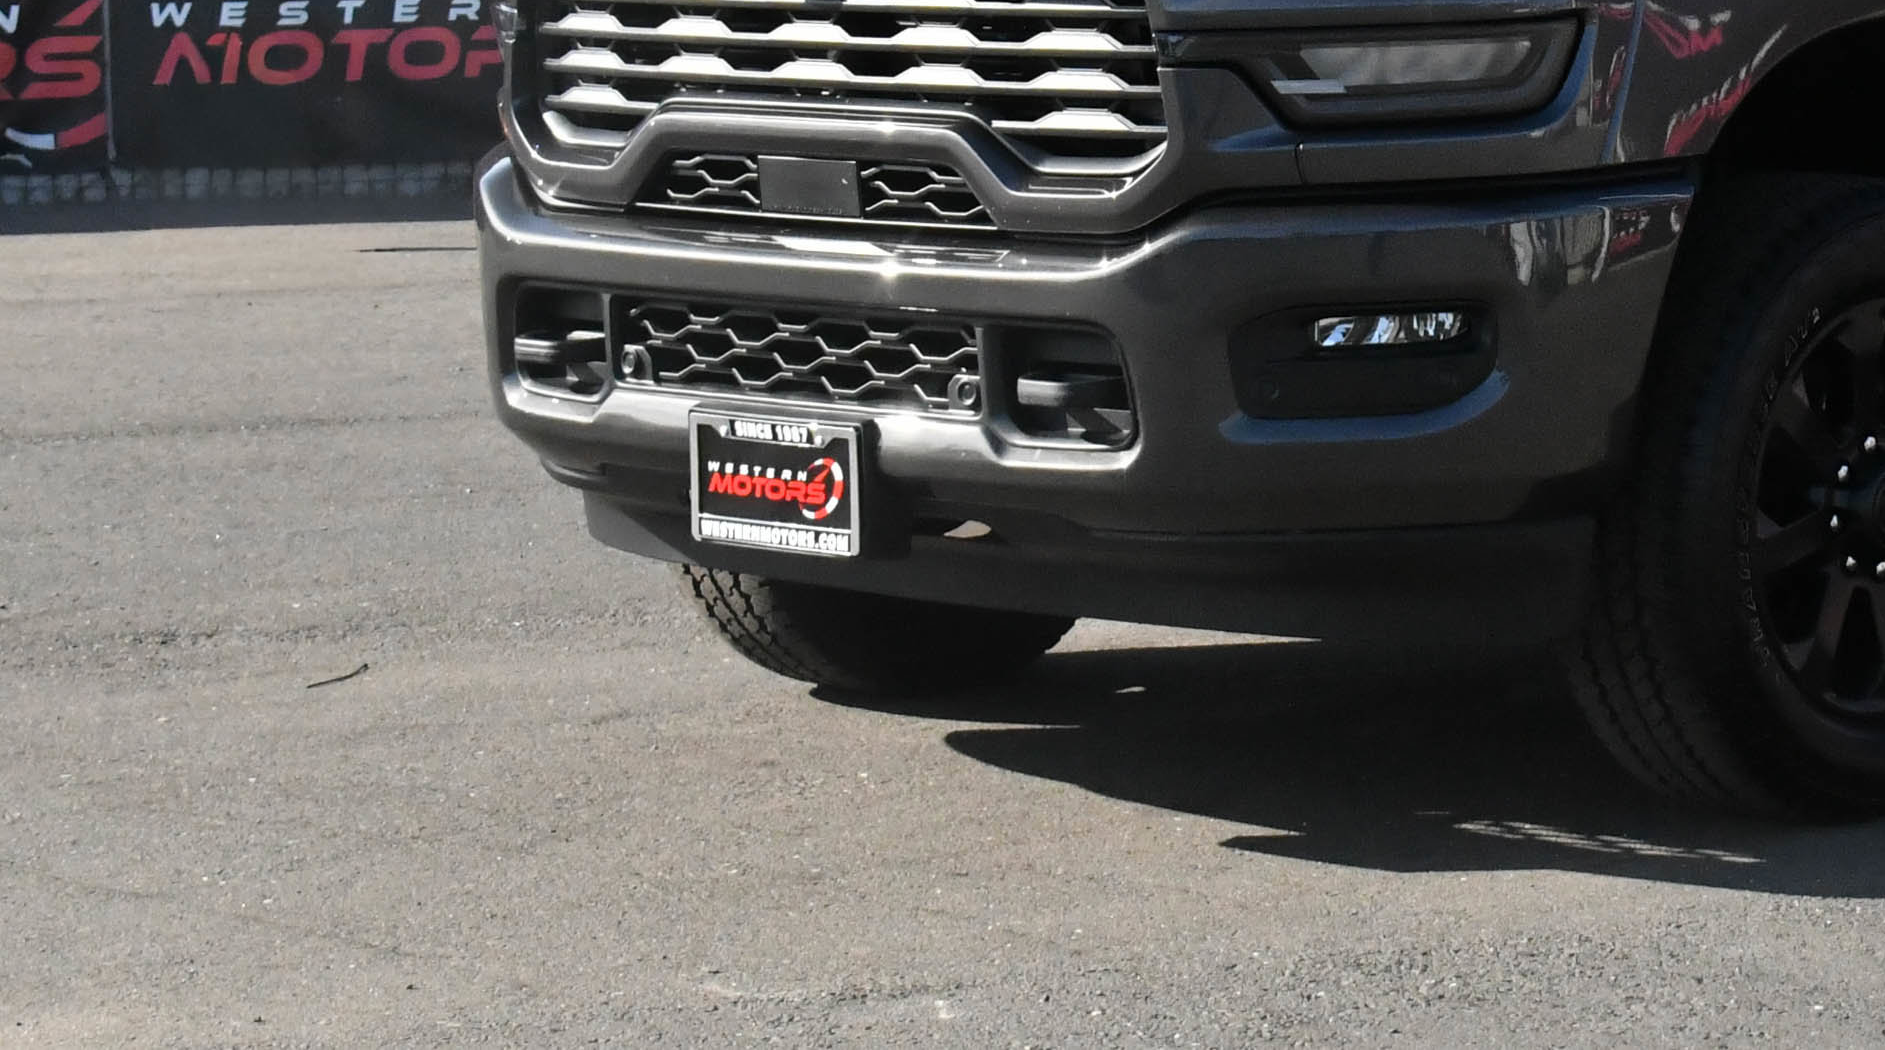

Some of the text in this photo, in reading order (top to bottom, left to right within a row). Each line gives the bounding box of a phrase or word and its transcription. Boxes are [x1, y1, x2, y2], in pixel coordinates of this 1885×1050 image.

[707, 460, 808, 482] WESTERN
[707, 471, 827, 505] MOTORS
[700, 518, 849, 552] WESTERNMOTORS.COM
